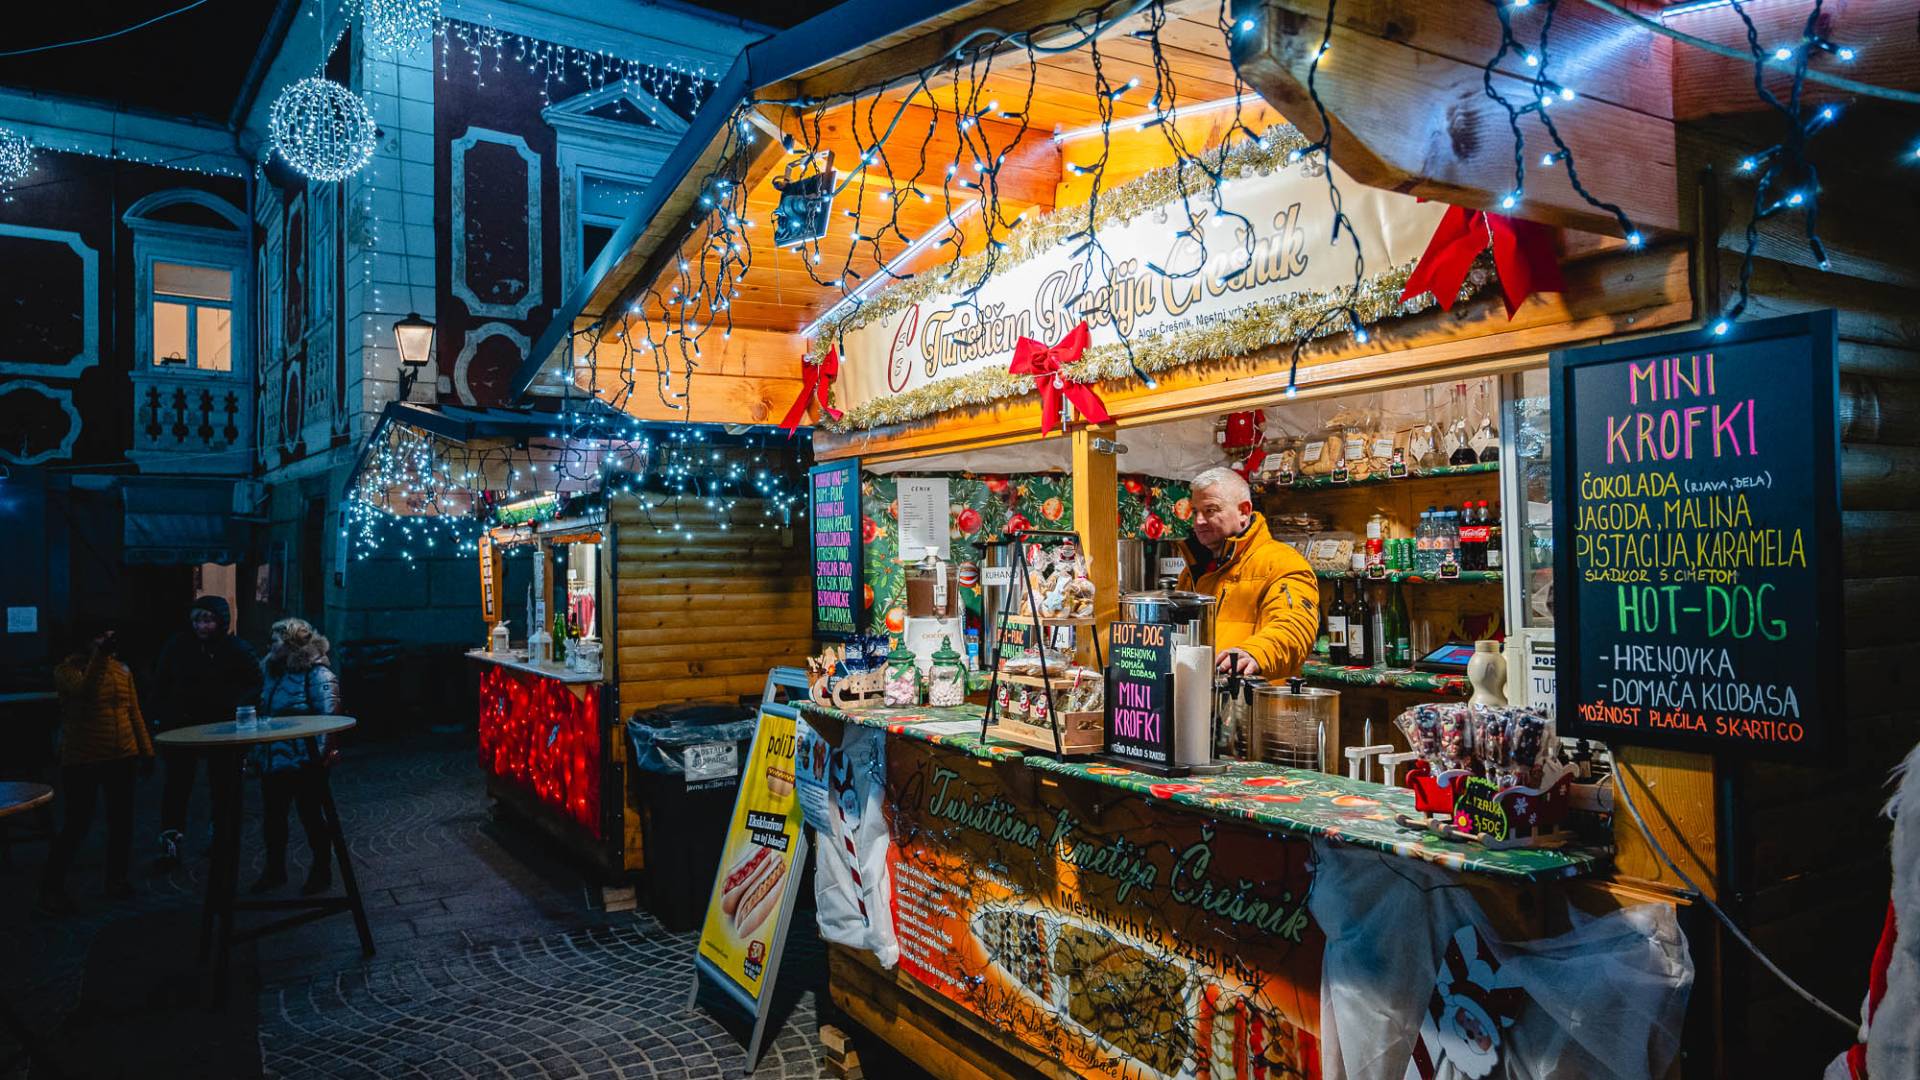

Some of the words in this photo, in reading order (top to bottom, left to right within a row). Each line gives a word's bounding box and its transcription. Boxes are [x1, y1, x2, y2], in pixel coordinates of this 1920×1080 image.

[1036, 258, 1156, 347] Kmetija
[1629, 353, 1715, 405] MINI
[1607, 399, 1758, 464] KROFKI
[1581, 472, 1680, 500] ČOKOLADA
[1664, 494, 1752, 529] MALINA
[1584, 569, 1650, 582] SLADKOR
[1660, 570, 1668, 582] S
[1618, 584, 1787, 641] HOT-DOG
[1113, 624, 1164, 647] HOT-DOG
[1119, 682, 1151, 710] MINI
[1702, 681, 1799, 718] KLOBASA
[1114, 707, 1160, 743] KROFKI
[1578, 700, 1641, 727] MOŽNOST
[1650, 706, 1707, 733] PLAČILA
[930, 767, 1041, 849] Turistična
[1048, 808, 1158, 904] Kmetija
[1170, 828, 1308, 943] Črešnik
[1061, 890, 1110, 927] Mestni
[1115, 913, 1140, 939] vrh
